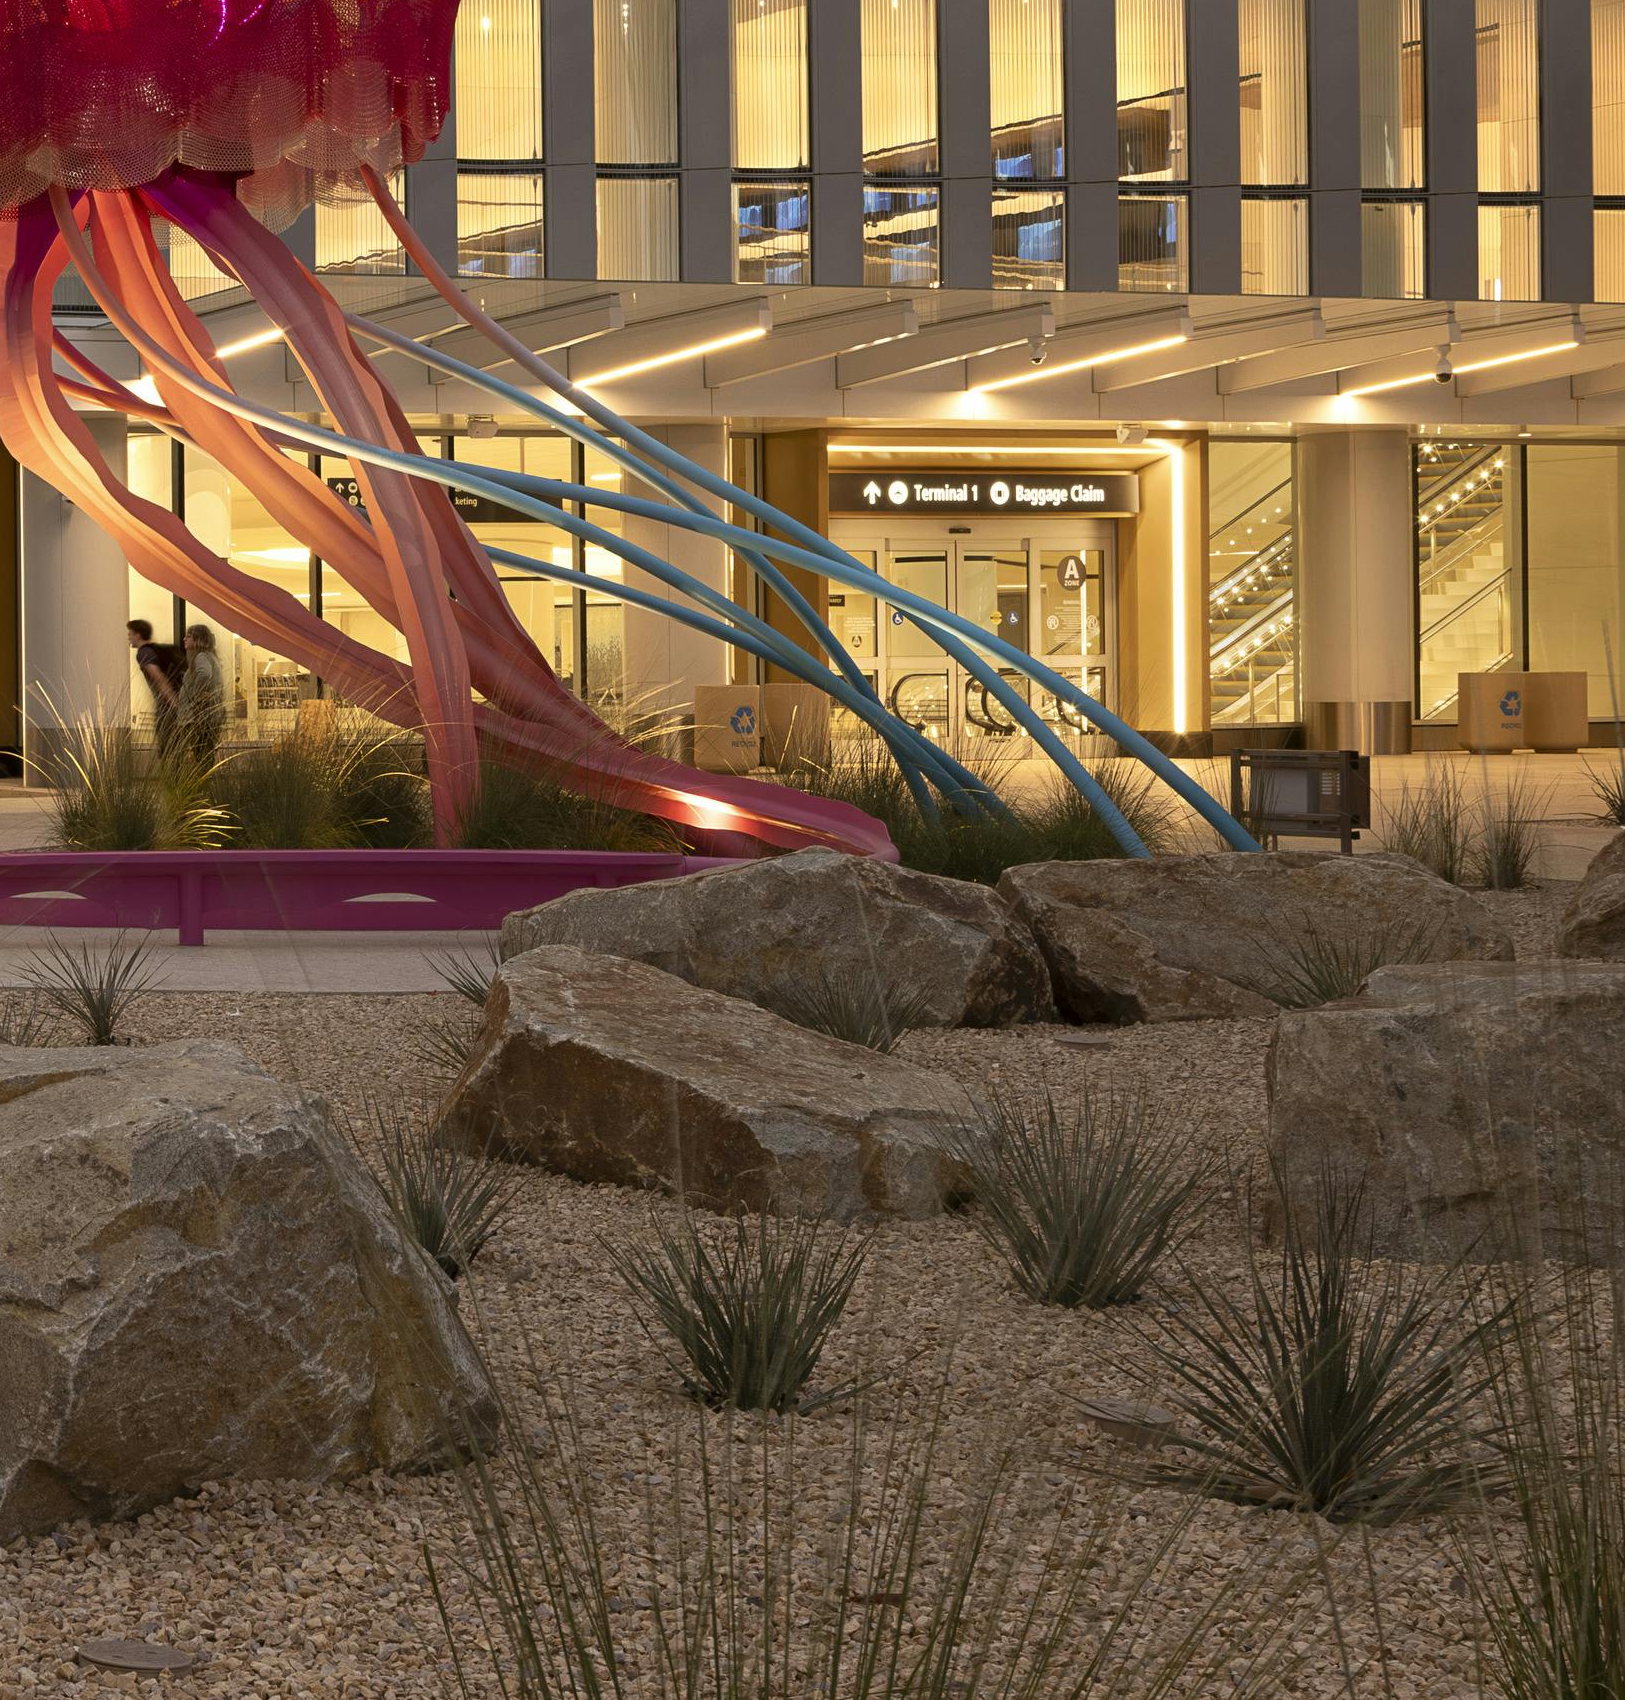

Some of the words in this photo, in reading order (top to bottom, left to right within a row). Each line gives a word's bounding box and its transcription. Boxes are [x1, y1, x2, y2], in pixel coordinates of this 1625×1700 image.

[455, 497, 478, 507] keting
[914, 484, 968, 502] Terminal
[971, 485, 978, 502] 1
[1015, 485, 1068, 506] Baggage
[1071, 485, 1104, 502] Claim
[1064, 559, 1080, 579] A
